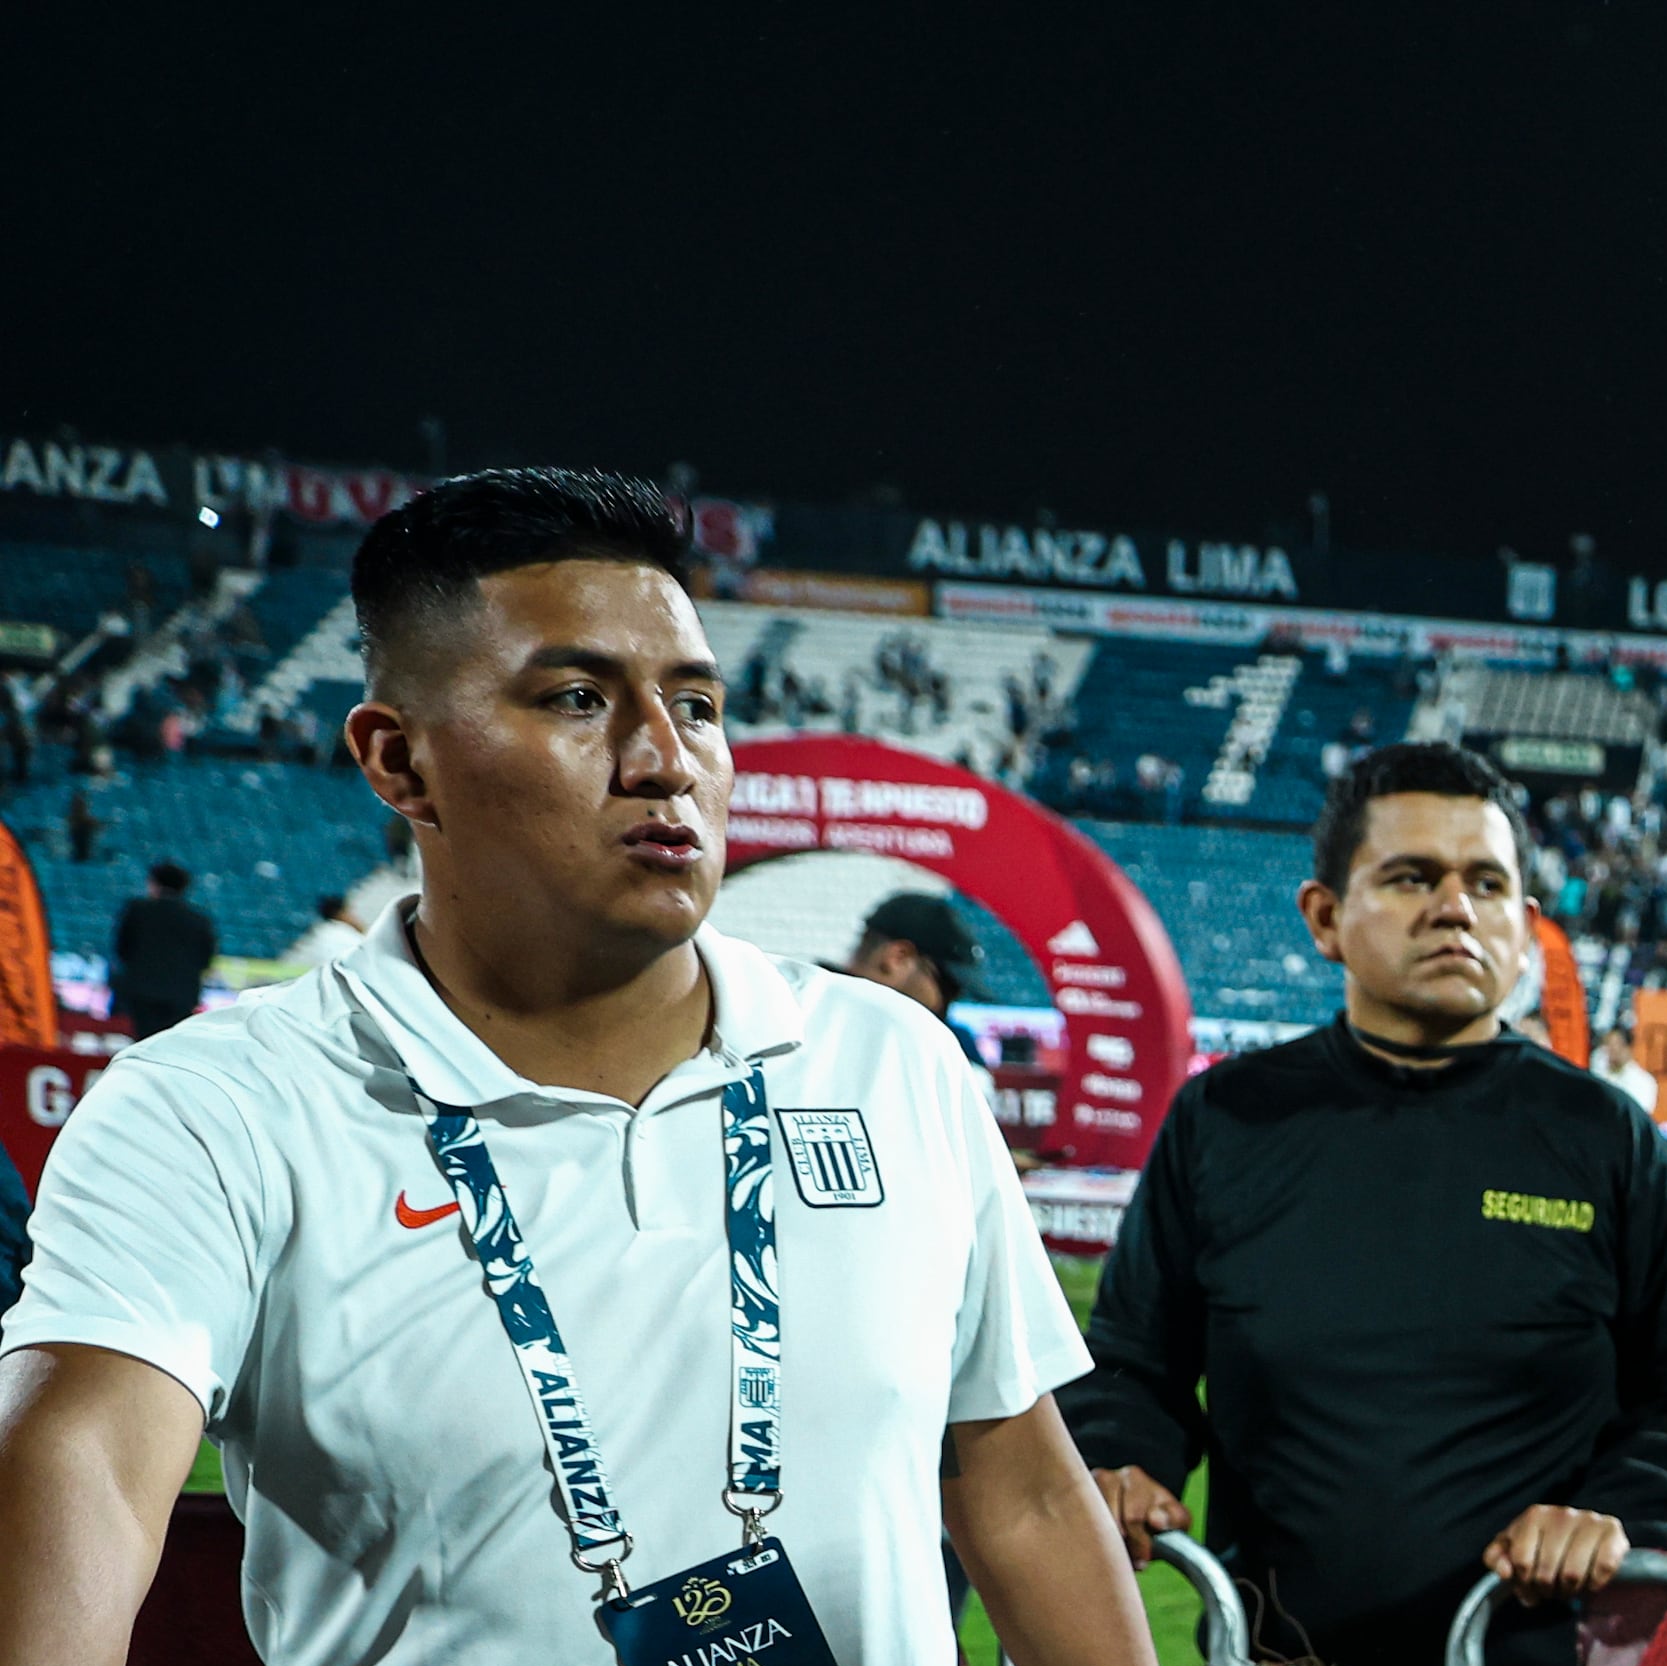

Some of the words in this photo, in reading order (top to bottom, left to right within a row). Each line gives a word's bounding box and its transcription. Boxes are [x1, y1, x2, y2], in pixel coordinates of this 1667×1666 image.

[908, 517, 1147, 590] ALIANZA
[1165, 536, 1299, 601] LIMA
[1481, 1188, 1596, 1233] SEGURIDAD
[531, 1369, 618, 1520] ALIANZ
[672, 1579, 732, 1627] 125
